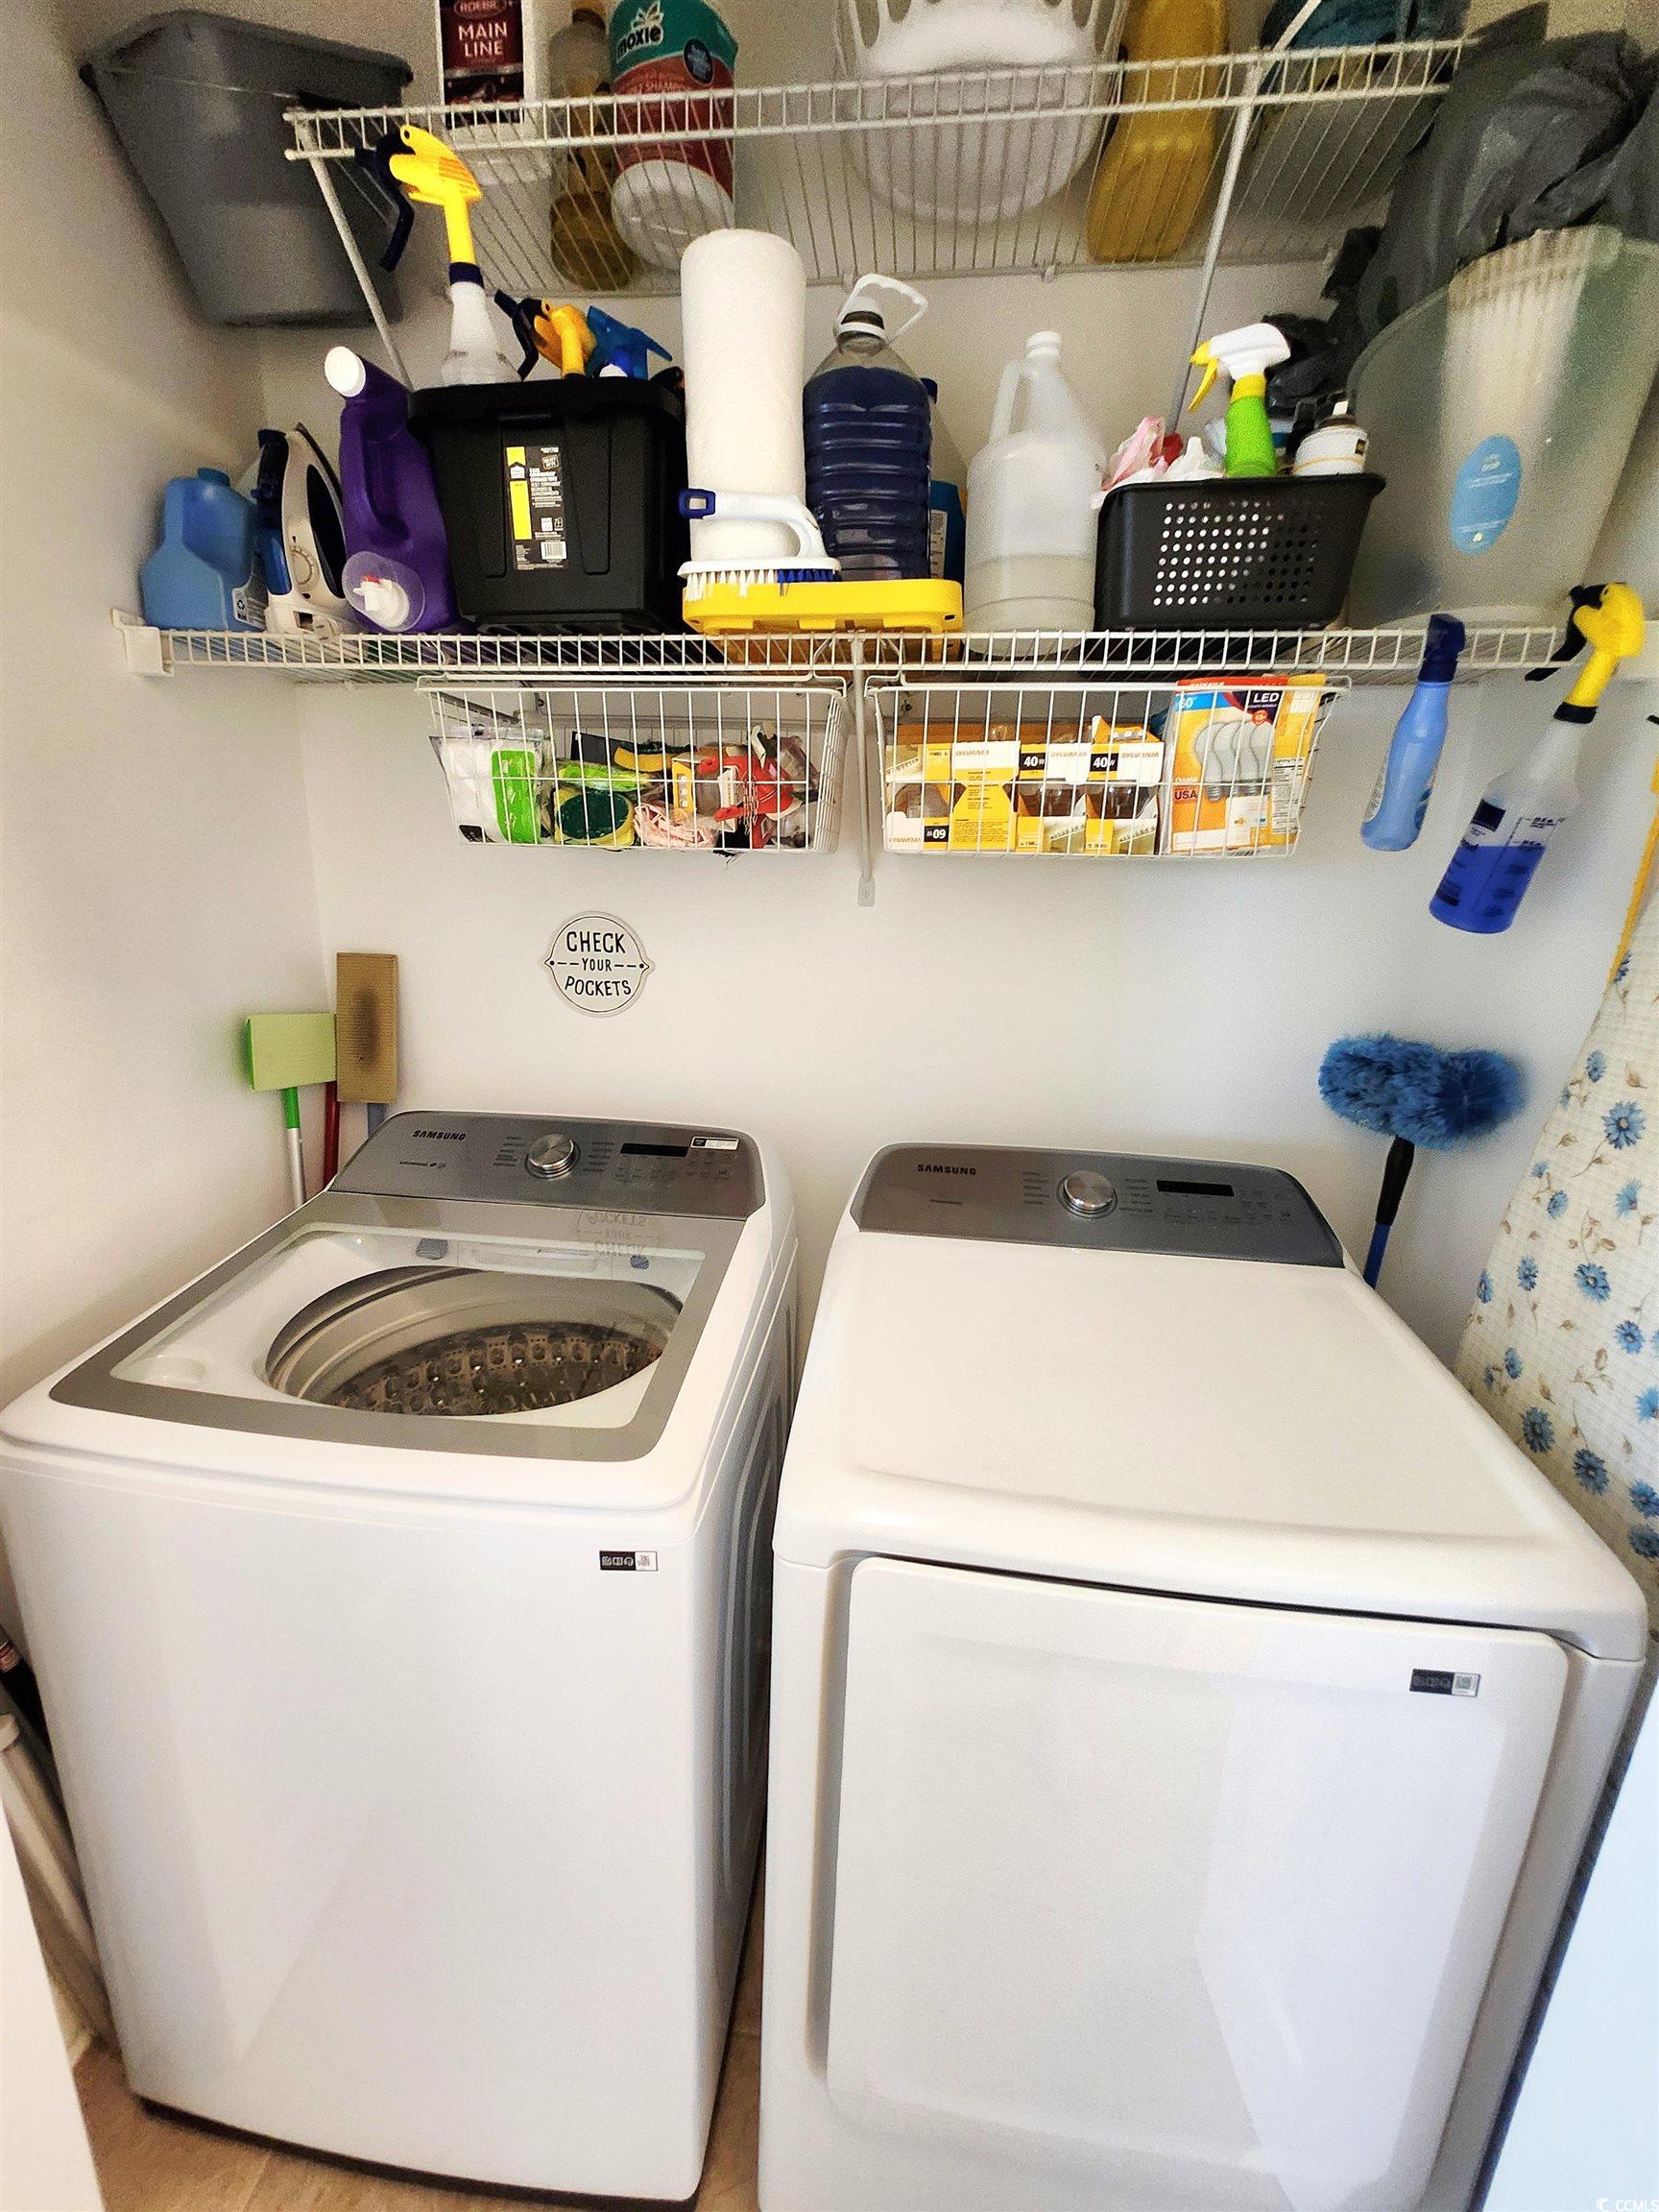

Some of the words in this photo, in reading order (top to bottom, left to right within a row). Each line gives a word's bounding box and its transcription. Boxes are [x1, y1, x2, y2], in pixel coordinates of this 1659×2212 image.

[458, 21, 508, 41] MAIN
[464, 39, 504, 58] LINE
[1253, 692, 1280, 703] LED
[1174, 789, 1198, 800] USA
[566, 930, 626, 953] CHECK
[582, 957, 613, 972] YOUR
[565, 975, 632, 997] POCKETS
[412, 1129, 467, 1141] SAMSUNG
[917, 1164, 976, 1175] SAMSUNG
